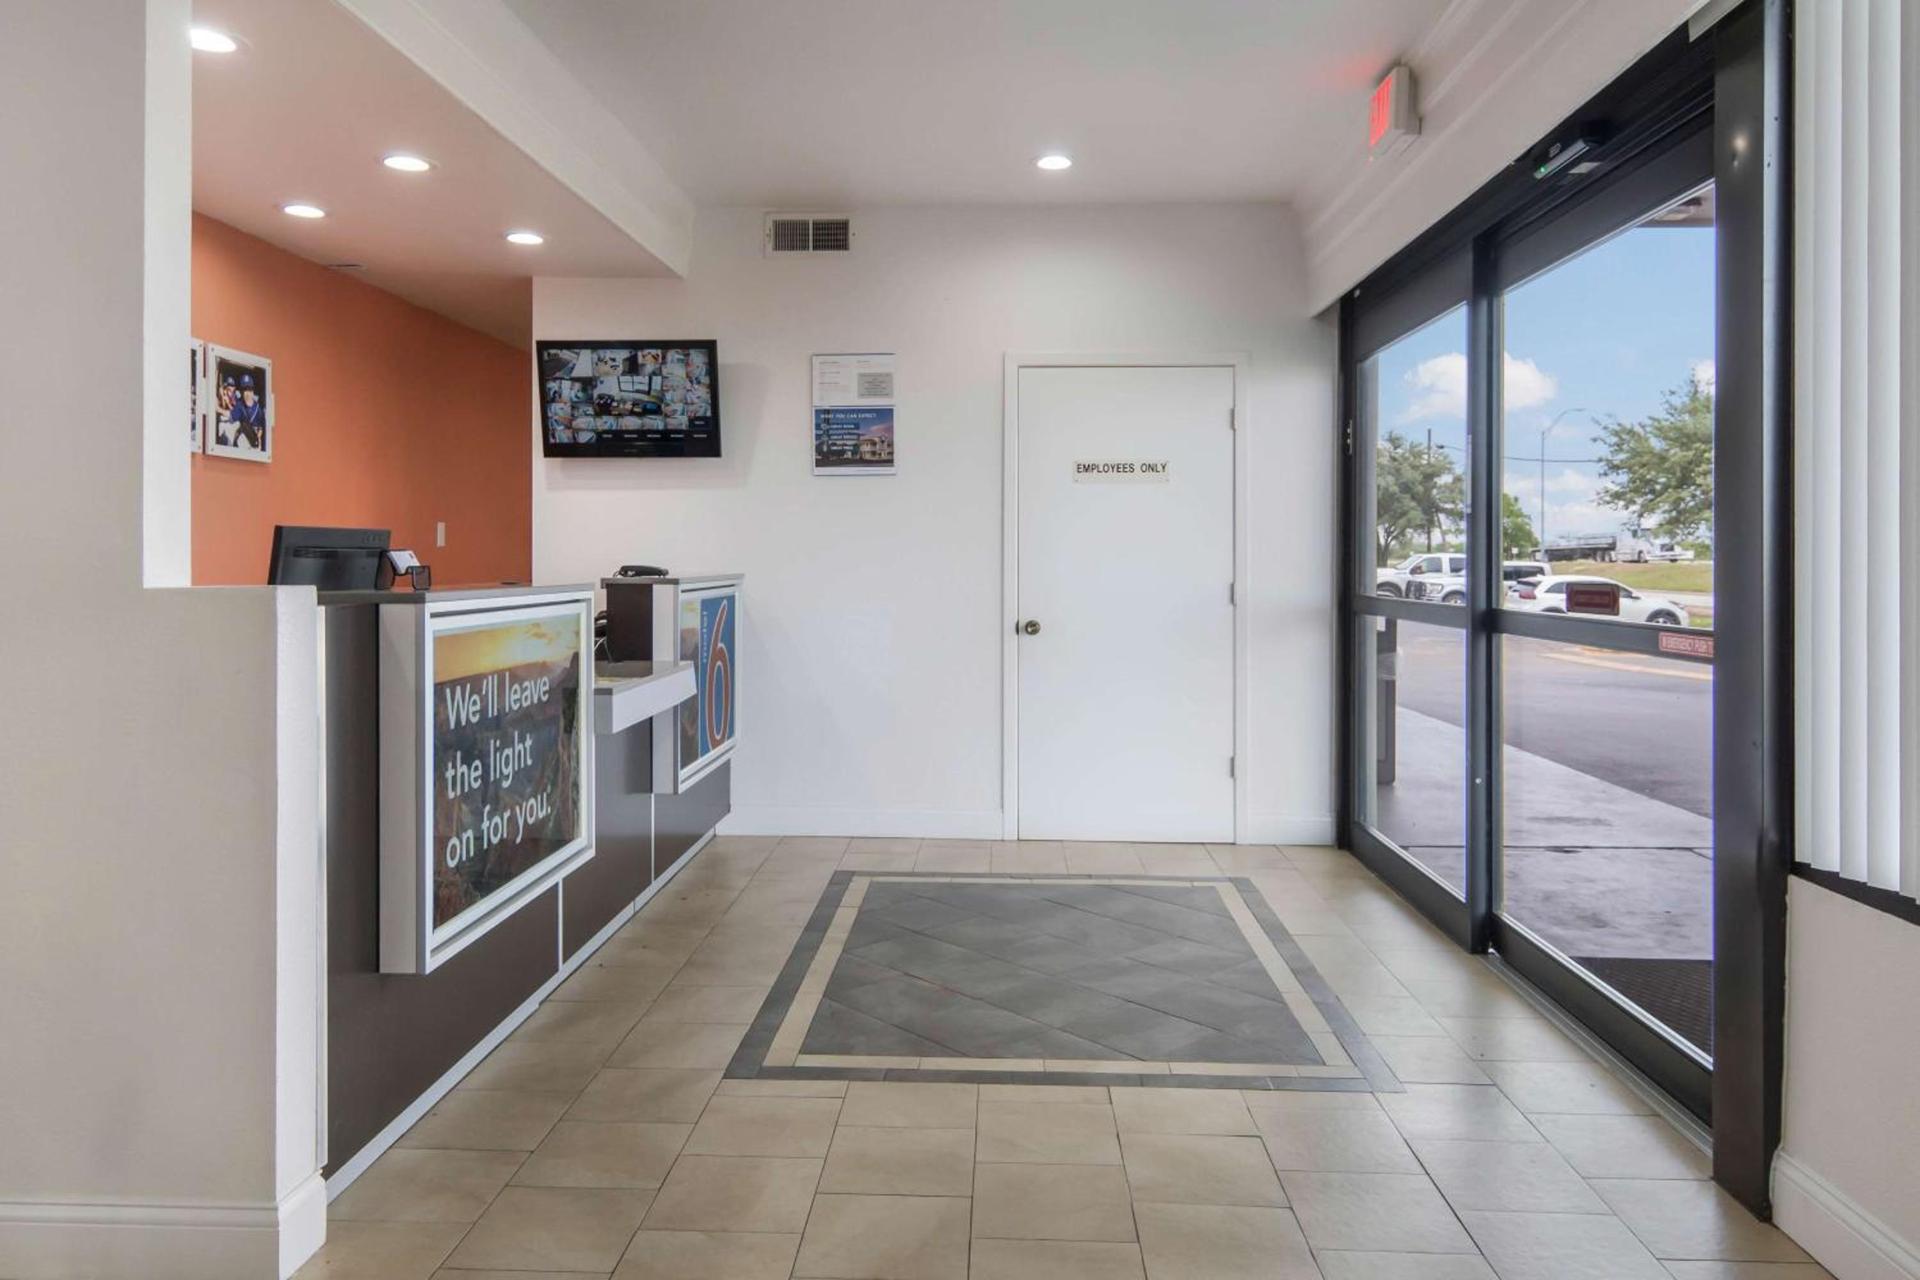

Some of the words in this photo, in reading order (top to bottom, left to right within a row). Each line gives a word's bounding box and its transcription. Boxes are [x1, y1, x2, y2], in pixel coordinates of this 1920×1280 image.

[1076, 463, 1135, 473] EMPLOYEES
[1140, 463, 1167, 473] ONLY
[446, 674, 498, 730] We'll
[505, 671, 550, 713] leave
[706, 599, 731, 750] 6
[445, 751, 482, 799] the
[490, 731, 534, 788] light
[446, 828, 475, 868] on
[482, 803, 511, 850] for
